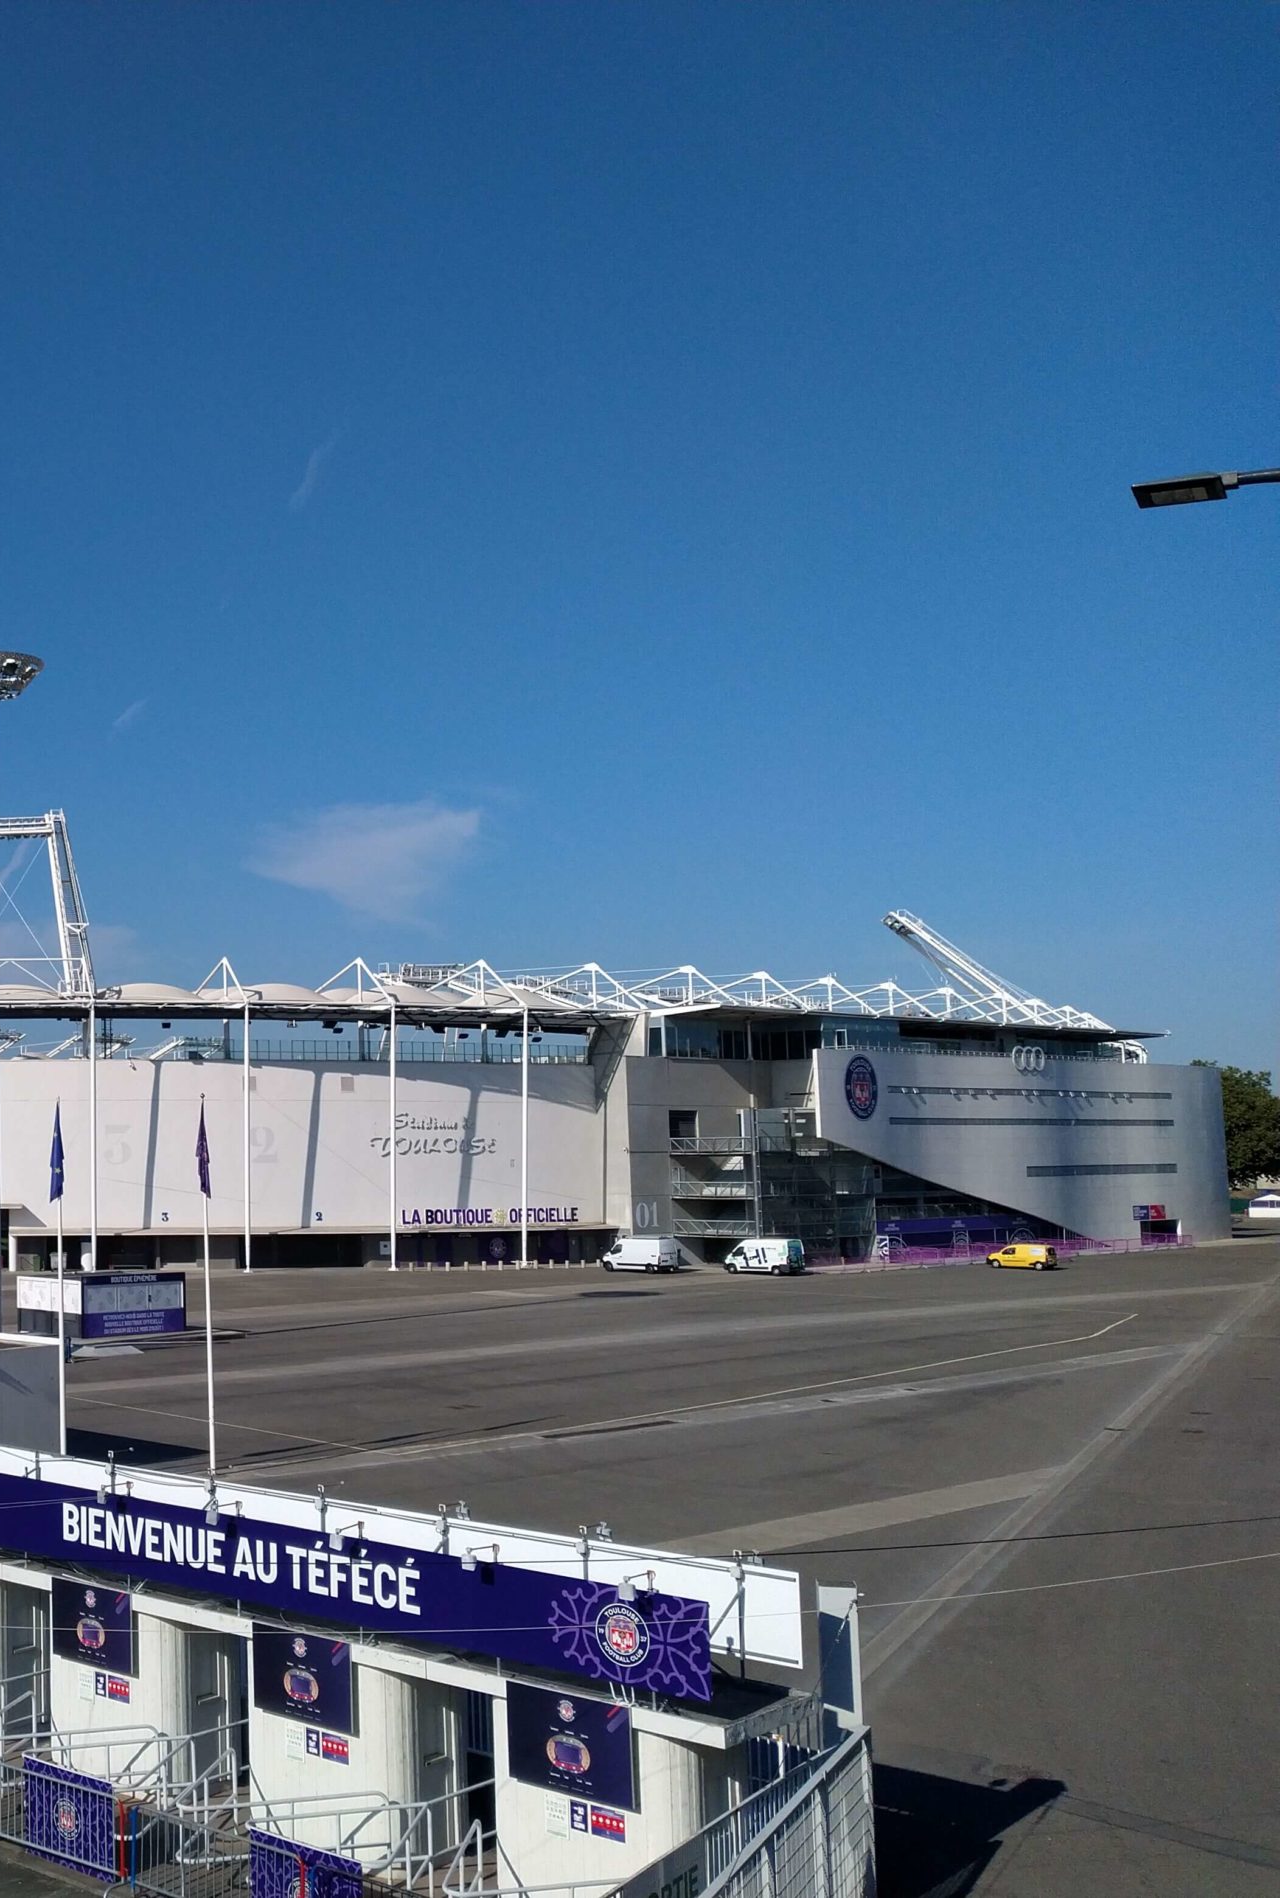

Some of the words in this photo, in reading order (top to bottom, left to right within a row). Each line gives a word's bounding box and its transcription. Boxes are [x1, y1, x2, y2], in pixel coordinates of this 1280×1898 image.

[161, 1212, 169, 1222] 3
[315, 1212, 323, 1221] 2
[402, 1209, 421, 1225] LA
[425, 1208, 493, 1225] BOUTIQUE
[635, 1202, 659, 1229] 01
[63, 1502, 226, 1575] BIENVENUE
[233, 1537, 278, 1584] AU
[286, 1541, 421, 1616] TÉFÉCÉ
[603, 1606, 640, 1624] TOULOUSE
[602, 1641, 631, 1663] FOOTBALL
[630, 1648, 644, 1662] CLUB
